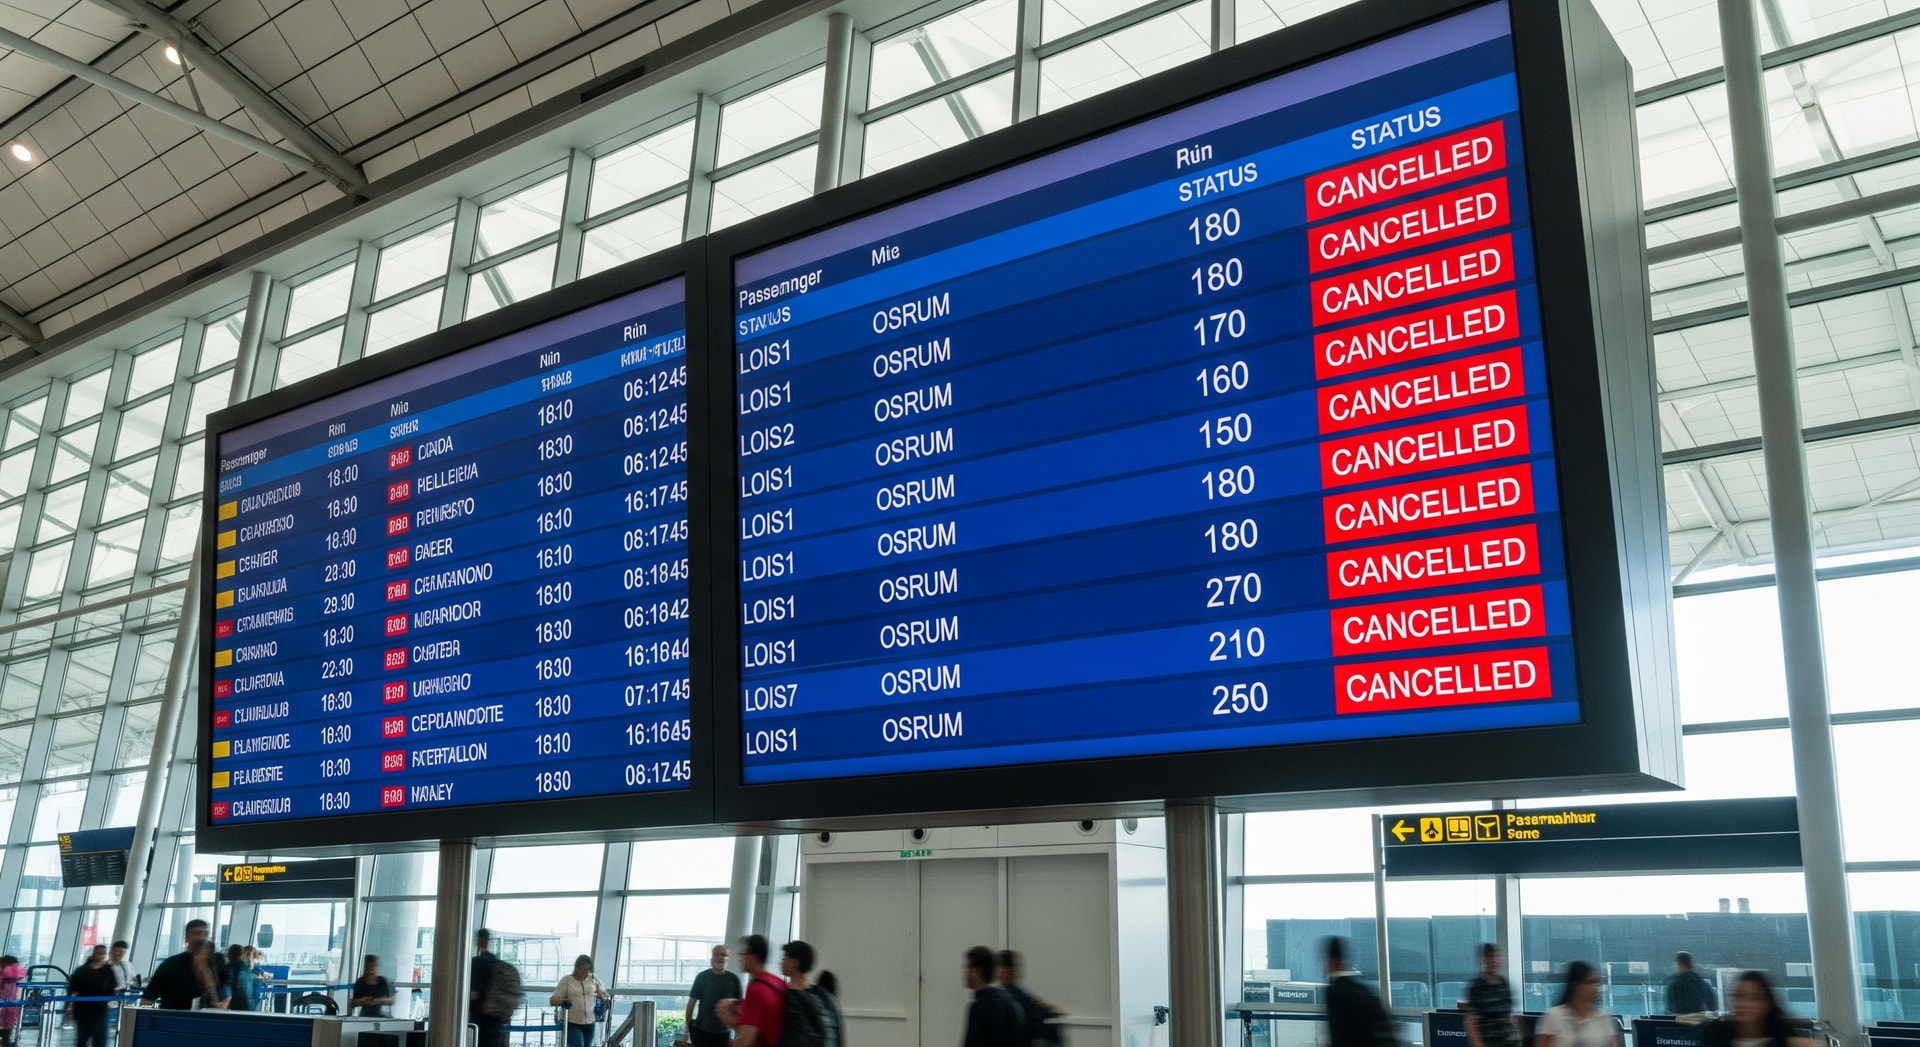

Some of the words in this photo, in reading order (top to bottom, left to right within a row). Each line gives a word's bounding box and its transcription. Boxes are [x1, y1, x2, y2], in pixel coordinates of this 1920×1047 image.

[1177, 161, 1257, 201] STATUS
[1352, 106, 1441, 149] STATUS
[740, 340, 789, 374] LOIS1
[873, 293, 949, 333] OSRUM
[1189, 208, 1240, 245] 180
[1317, 134, 1495, 209] CANCELLED
[741, 381, 790, 414] LOIS1
[874, 337, 950, 377] OSRUM
[1192, 258, 1242, 294] 180
[1318, 190, 1499, 261] CANCELLED
[741, 423, 794, 456] LOIS2
[875, 383, 952, 422] OSRUM
[1194, 310, 1245, 346] 170
[1320, 246, 1503, 315] CANCELLED
[742, 466, 791, 497] LOIS1
[876, 428, 953, 466] OSRUM
[1197, 361, 1248, 396] 160
[1323, 303, 1507, 368] CANCELLED
[538, 435, 572, 460] 1830
[743, 508, 792, 539] LOIS1
[877, 474, 954, 510] OSRUM
[1200, 414, 1251, 448] 150
[1327, 360, 1512, 423] CANCELLED
[743, 551, 793, 581] LOIS1
[878, 522, 955, 556] OSRUM
[1202, 466, 1254, 499] 180
[1330, 415, 1515, 475] CANCELLED
[744, 595, 794, 624] LOIS1
[880, 568, 957, 602] OSRUM
[1205, 519, 1257, 553] 180
[1336, 478, 1520, 530] CANCELLED
[745, 640, 794, 667] LOIS1
[880, 616, 958, 648] OSRUM
[1207, 573, 1261, 607] 270
[1339, 538, 1525, 586] CANCELLED
[322, 658, 353, 679] 22:30
[536, 619, 571, 643] 1830
[324, 625, 353, 646] 18:30
[746, 684, 797, 711] LOIS7
[882, 664, 960, 695] OSRUM
[1210, 627, 1264, 661] 210
[1344, 598, 1530, 644] CANCELLED
[321, 725, 351, 744] 18:30
[625, 679, 690, 706] 07:1745
[747, 728, 796, 754] LOIS1
[883, 712, 962, 742] OSRUM
[1213, 682, 1268, 715] 250
[1347, 660, 1535, 702] CANCELLED
[320, 792, 350, 810] 18:30
[536, 771, 570, 792] 1830
[321, 758, 350, 777] 18:30
